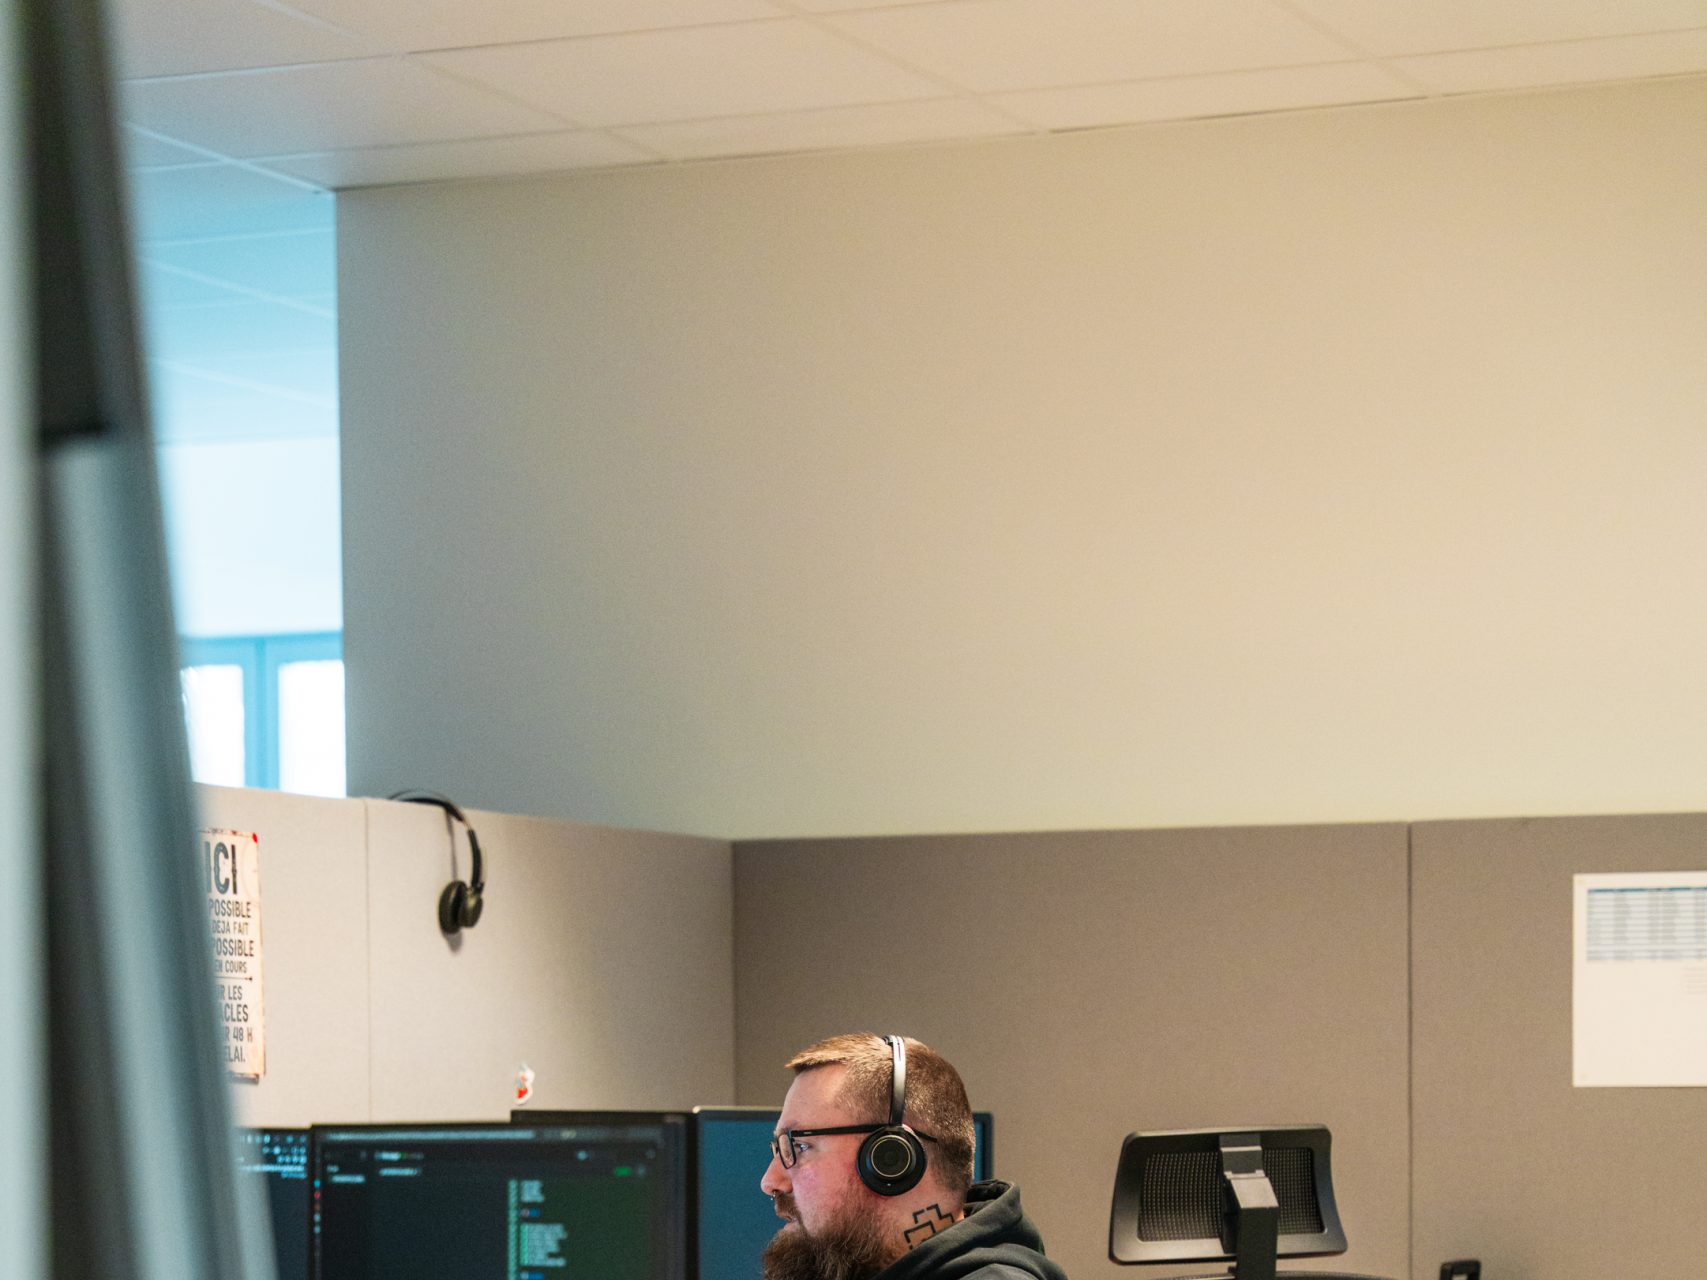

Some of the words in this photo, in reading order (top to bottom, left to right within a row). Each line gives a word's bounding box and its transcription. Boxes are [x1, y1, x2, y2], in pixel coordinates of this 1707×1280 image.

[233, 921, 249, 935] FAIT
[224, 960, 247, 973] COURS
[228, 985, 242, 1001] LES
[233, 1027, 244, 1042] 48
